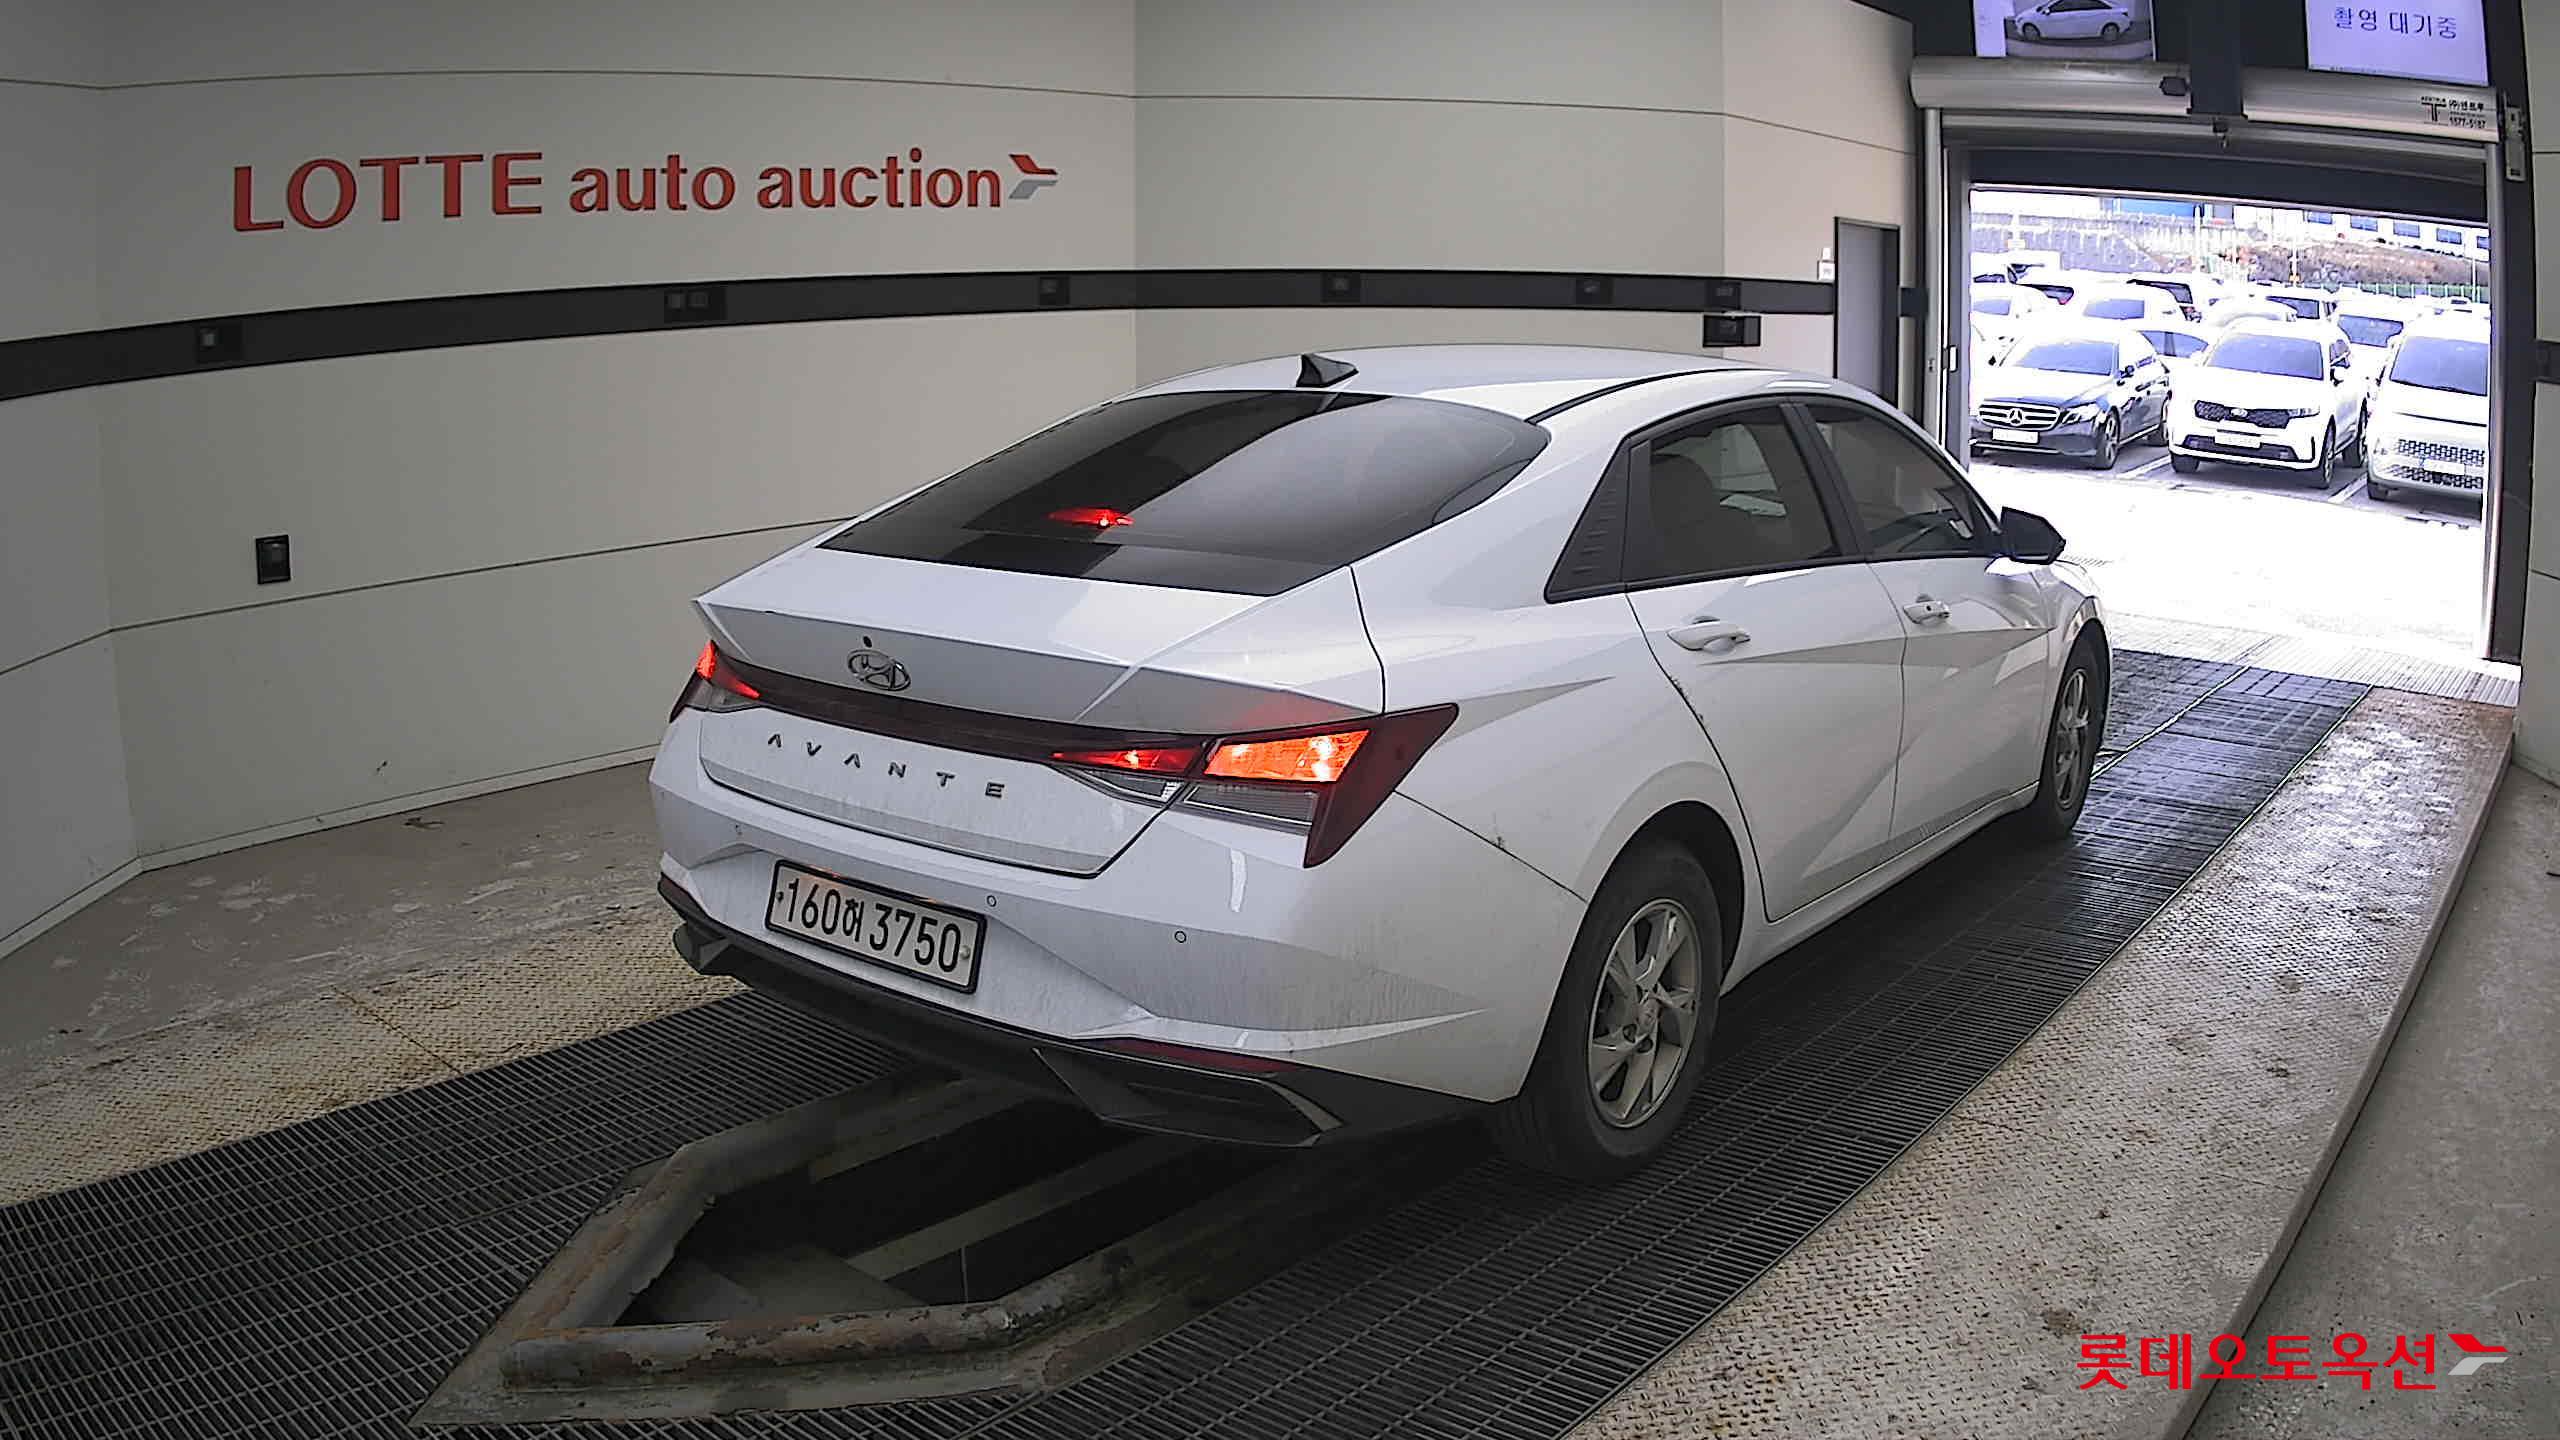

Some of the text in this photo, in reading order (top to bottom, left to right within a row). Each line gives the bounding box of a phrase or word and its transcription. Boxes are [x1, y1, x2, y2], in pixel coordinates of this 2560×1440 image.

[2335, 7, 2456, 39] 촬영 대기중
[234, 149, 1001, 231] LOTTE auto auction
[767, 733, 1005, 797] AVANTE
[869, 902, 961, 972] 3750
